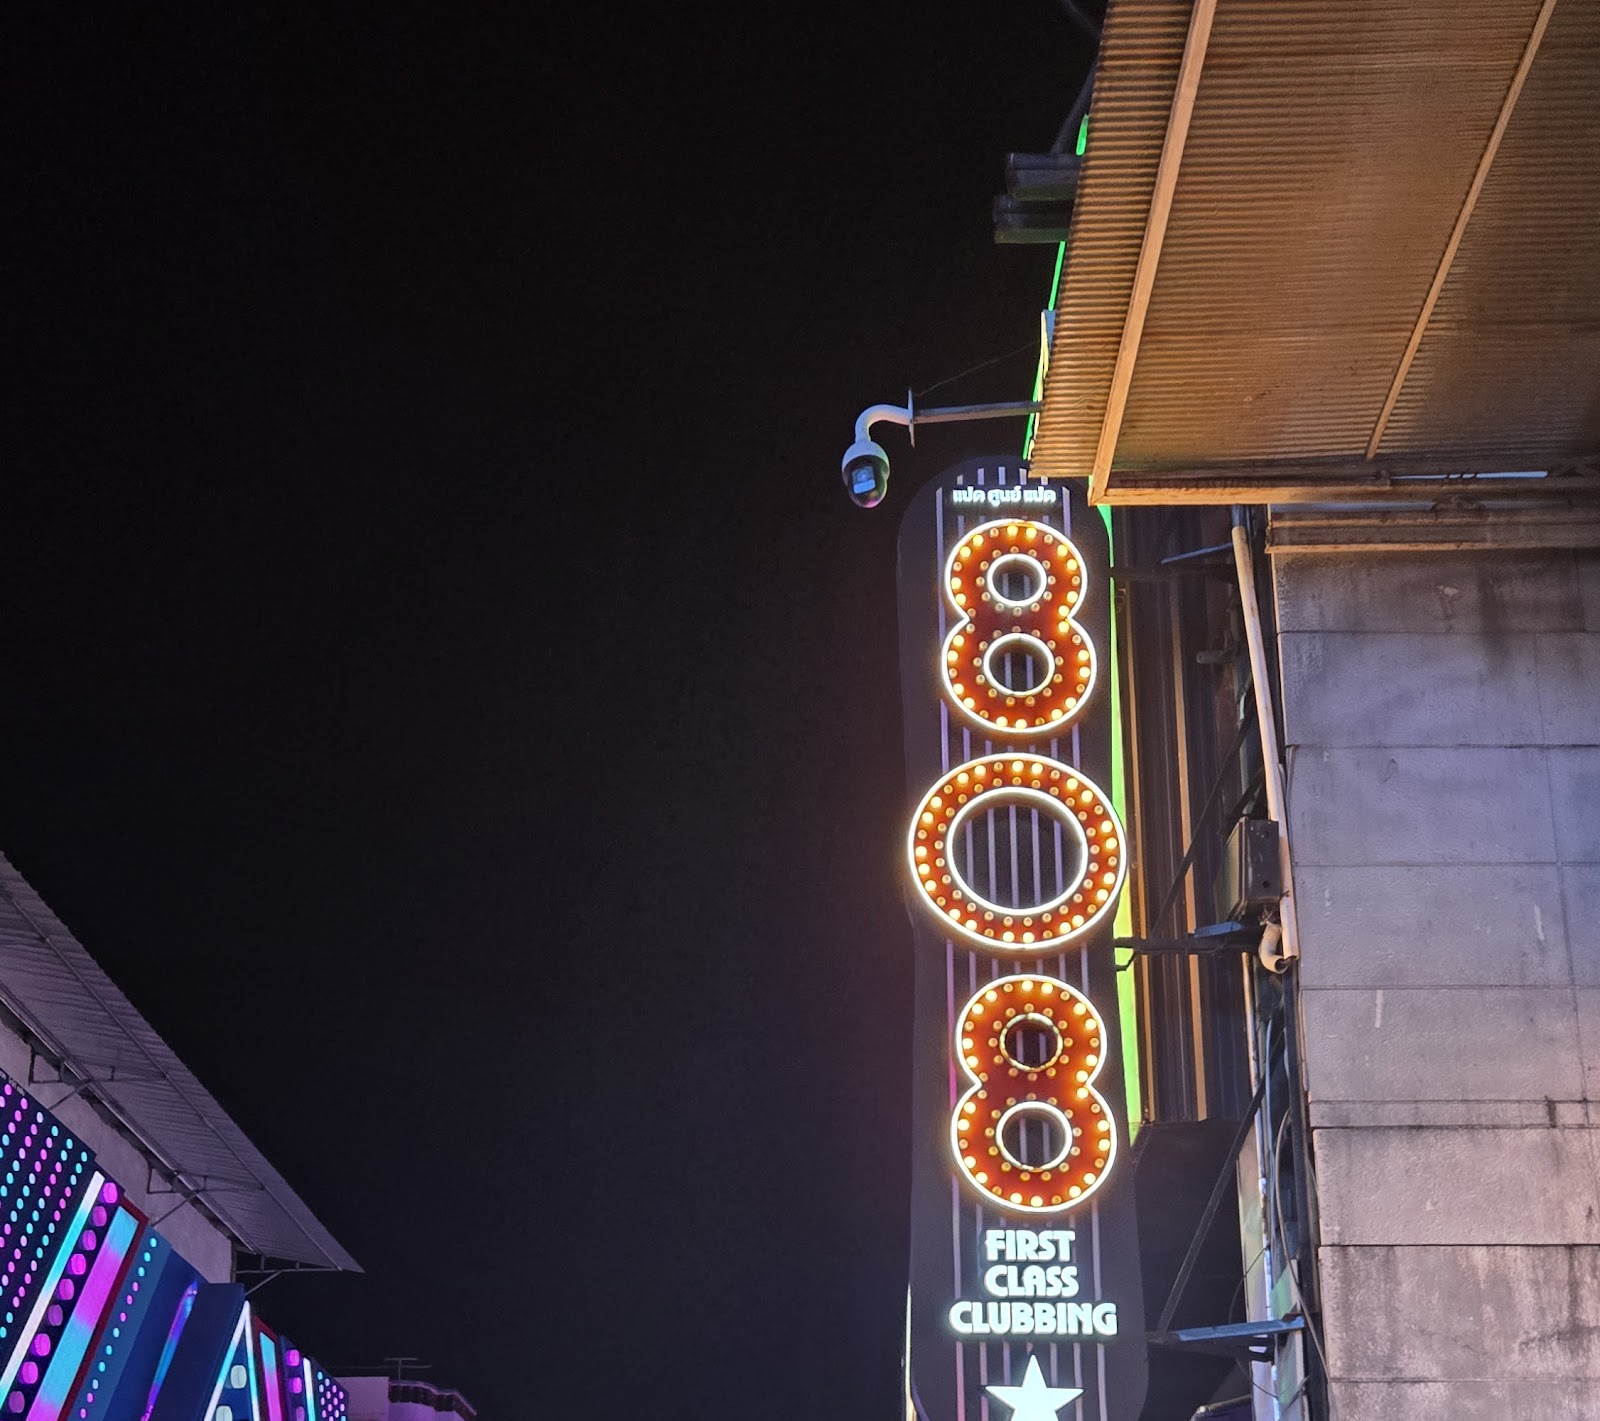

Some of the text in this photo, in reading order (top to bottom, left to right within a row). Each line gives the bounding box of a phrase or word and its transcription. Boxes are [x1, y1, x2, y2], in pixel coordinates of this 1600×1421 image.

[985, 1229, 1075, 1262] FIRST
[984, 1265, 1079, 1298] CLASS
[949, 1301, 1118, 1336] CLUBBING
